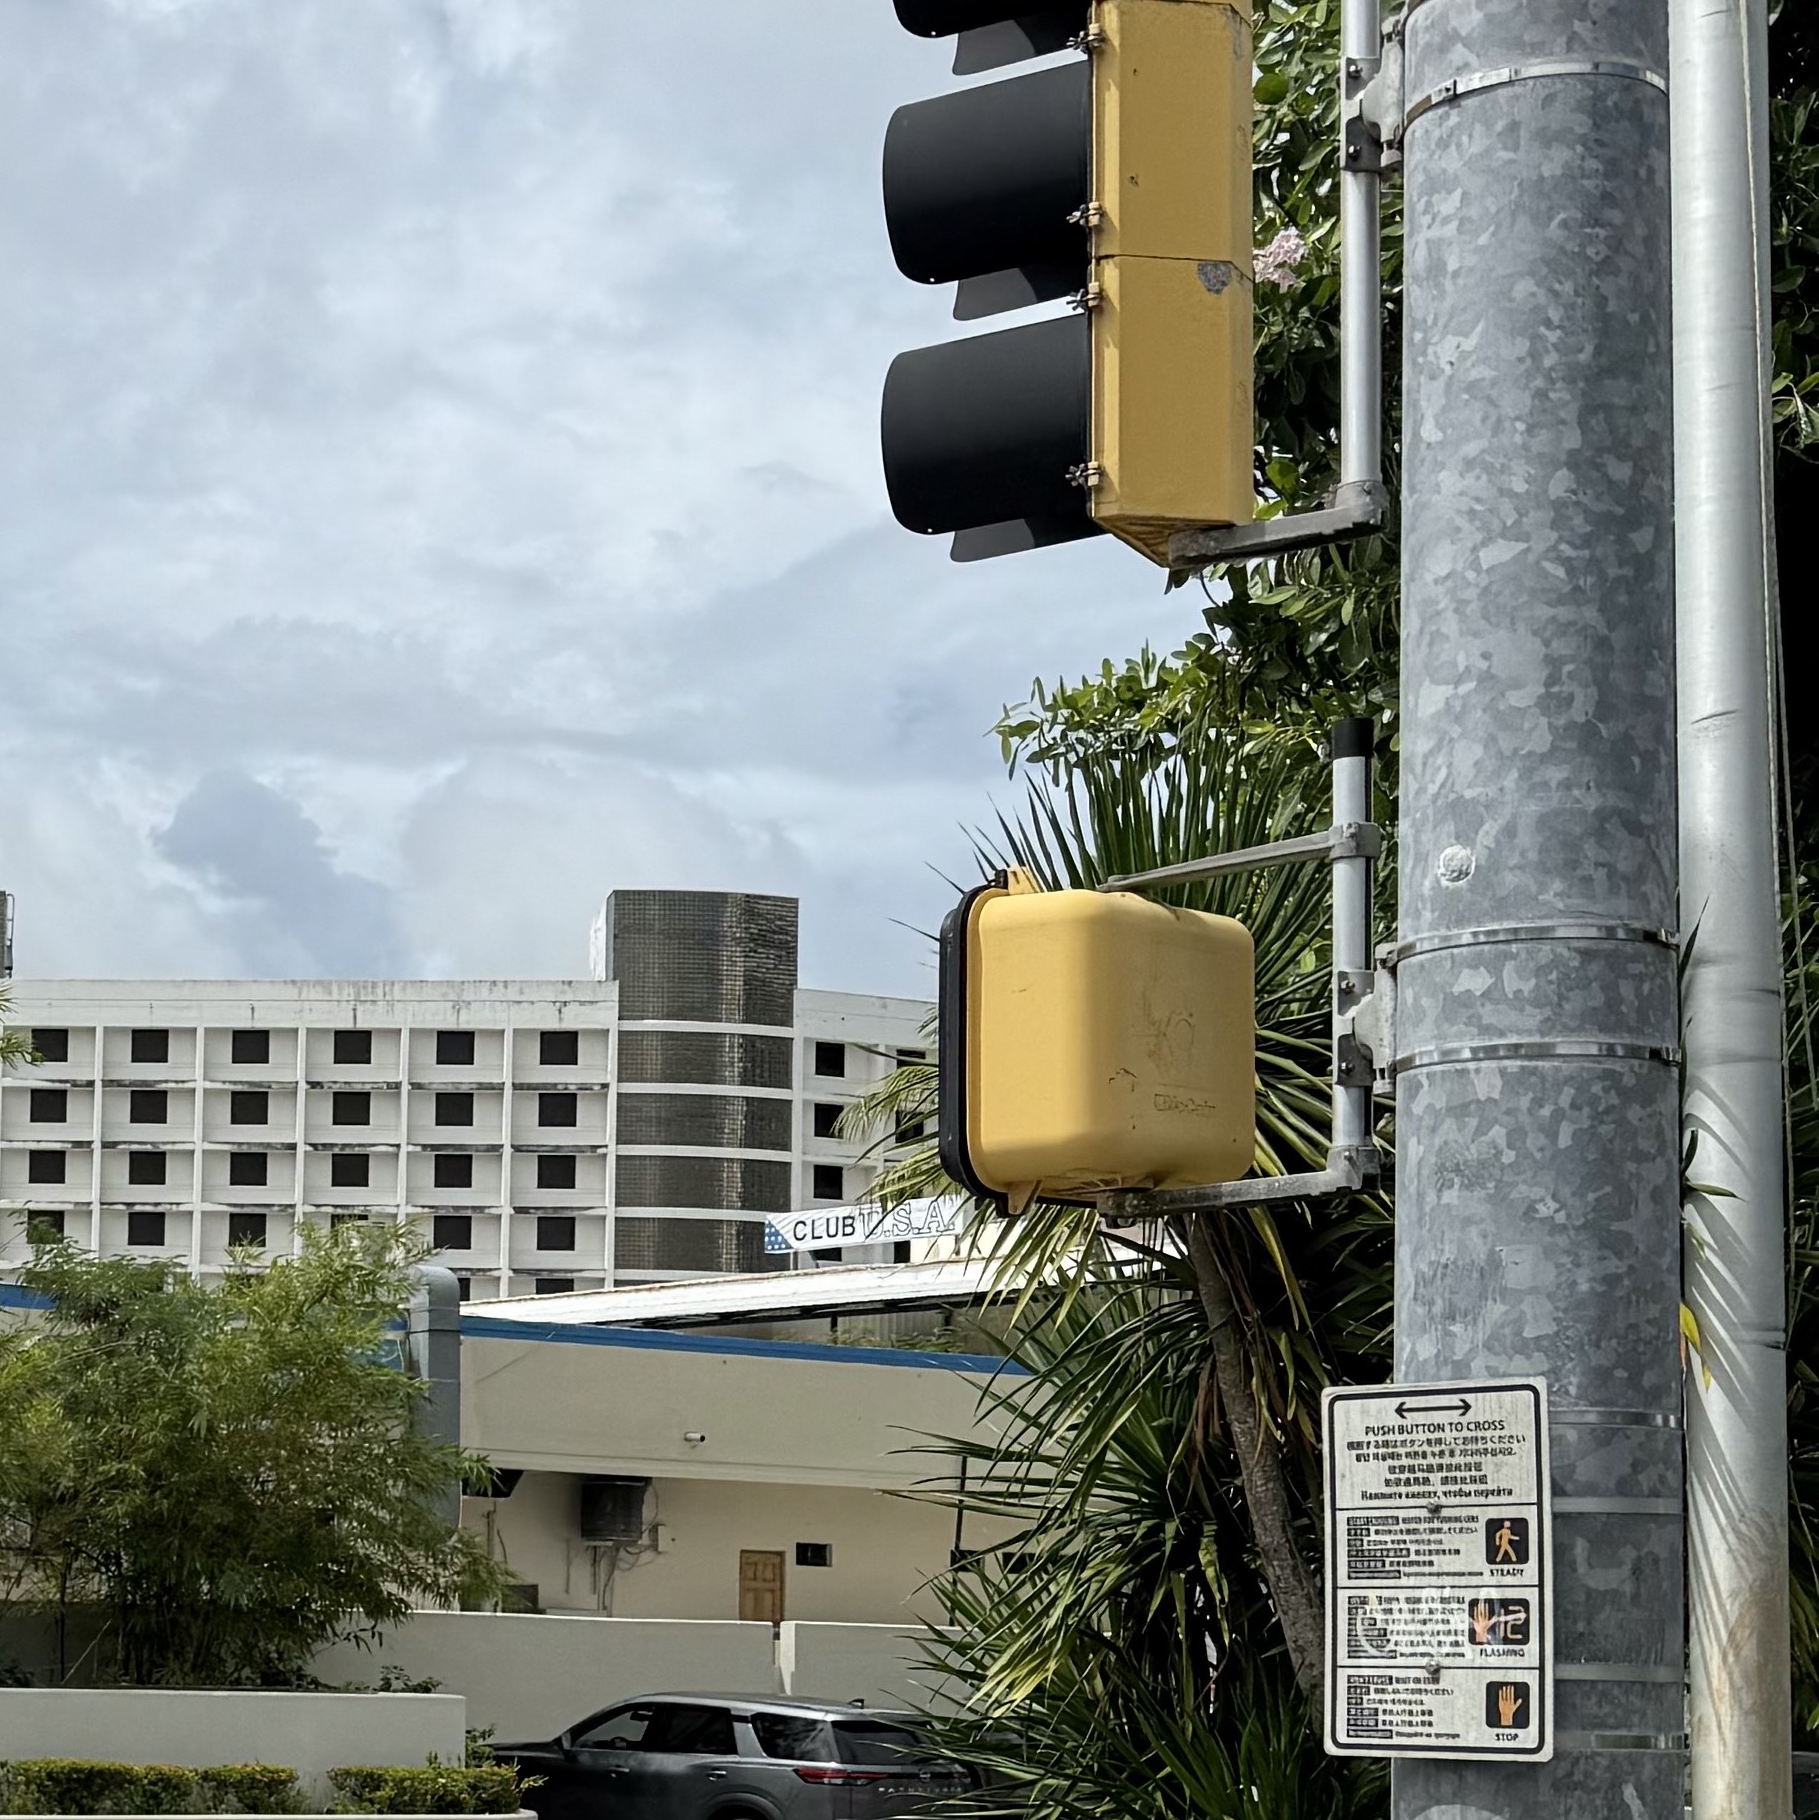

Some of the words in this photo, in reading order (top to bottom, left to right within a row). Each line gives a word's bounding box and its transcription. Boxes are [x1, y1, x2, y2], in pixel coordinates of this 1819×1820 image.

[793, 1215, 855, 1241] CLUB
[1365, 1425, 1395, 1436] PUSH
[1397, 1423, 1445, 1435] BUTTON
[1449, 1422, 1463, 1432] TO
[1466, 1420, 1505, 1431] CROSS
[1495, 1733, 1519, 1741] STOP
